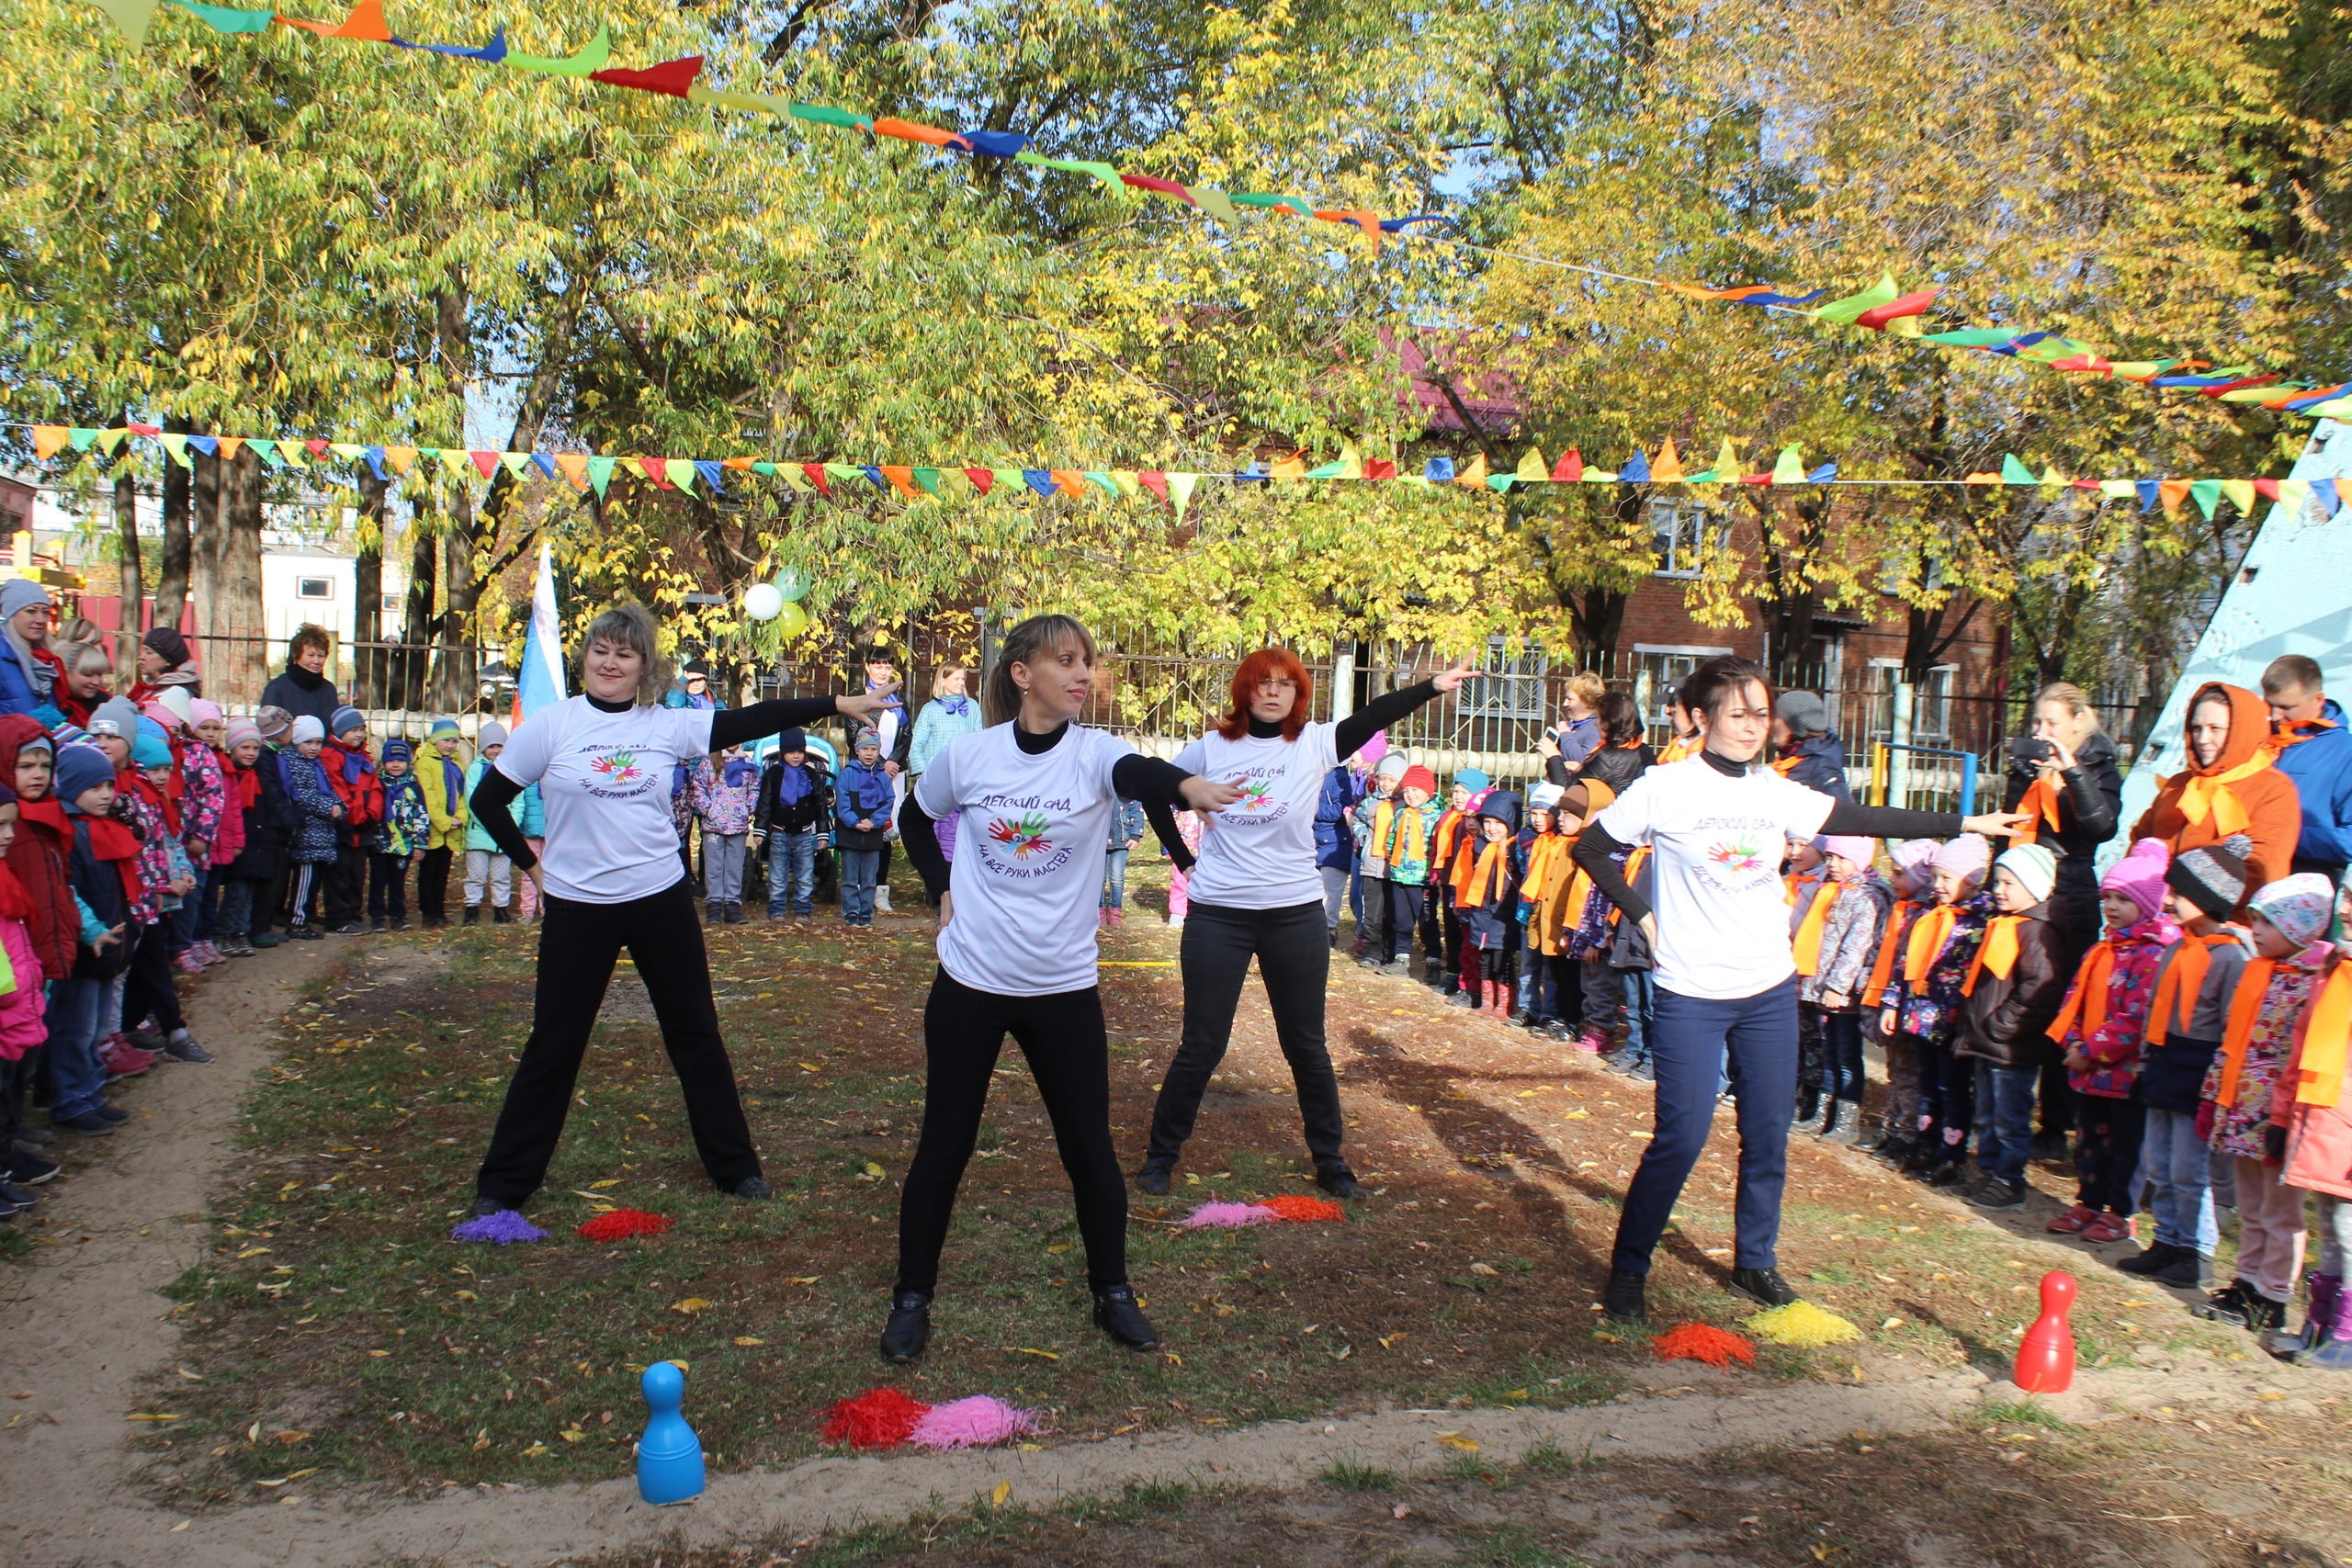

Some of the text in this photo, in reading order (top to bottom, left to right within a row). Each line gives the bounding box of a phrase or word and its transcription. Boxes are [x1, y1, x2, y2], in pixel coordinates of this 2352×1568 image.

[579, 773, 659, 799] НА ВСЕ РУКИ МАСТЕРА
[978, 795, 1071, 812] ДЕТСКИЙ САД
[1220, 812, 1238, 824] ВСЕ
[1238, 818, 1259, 826] РУКИ
[1261, 801, 1290, 825] МАСТЕРА
[1015, 835, 1027, 843] 26
[978, 843, 1073, 879] НА ВСЕ РУКИ МАСТЕРА
